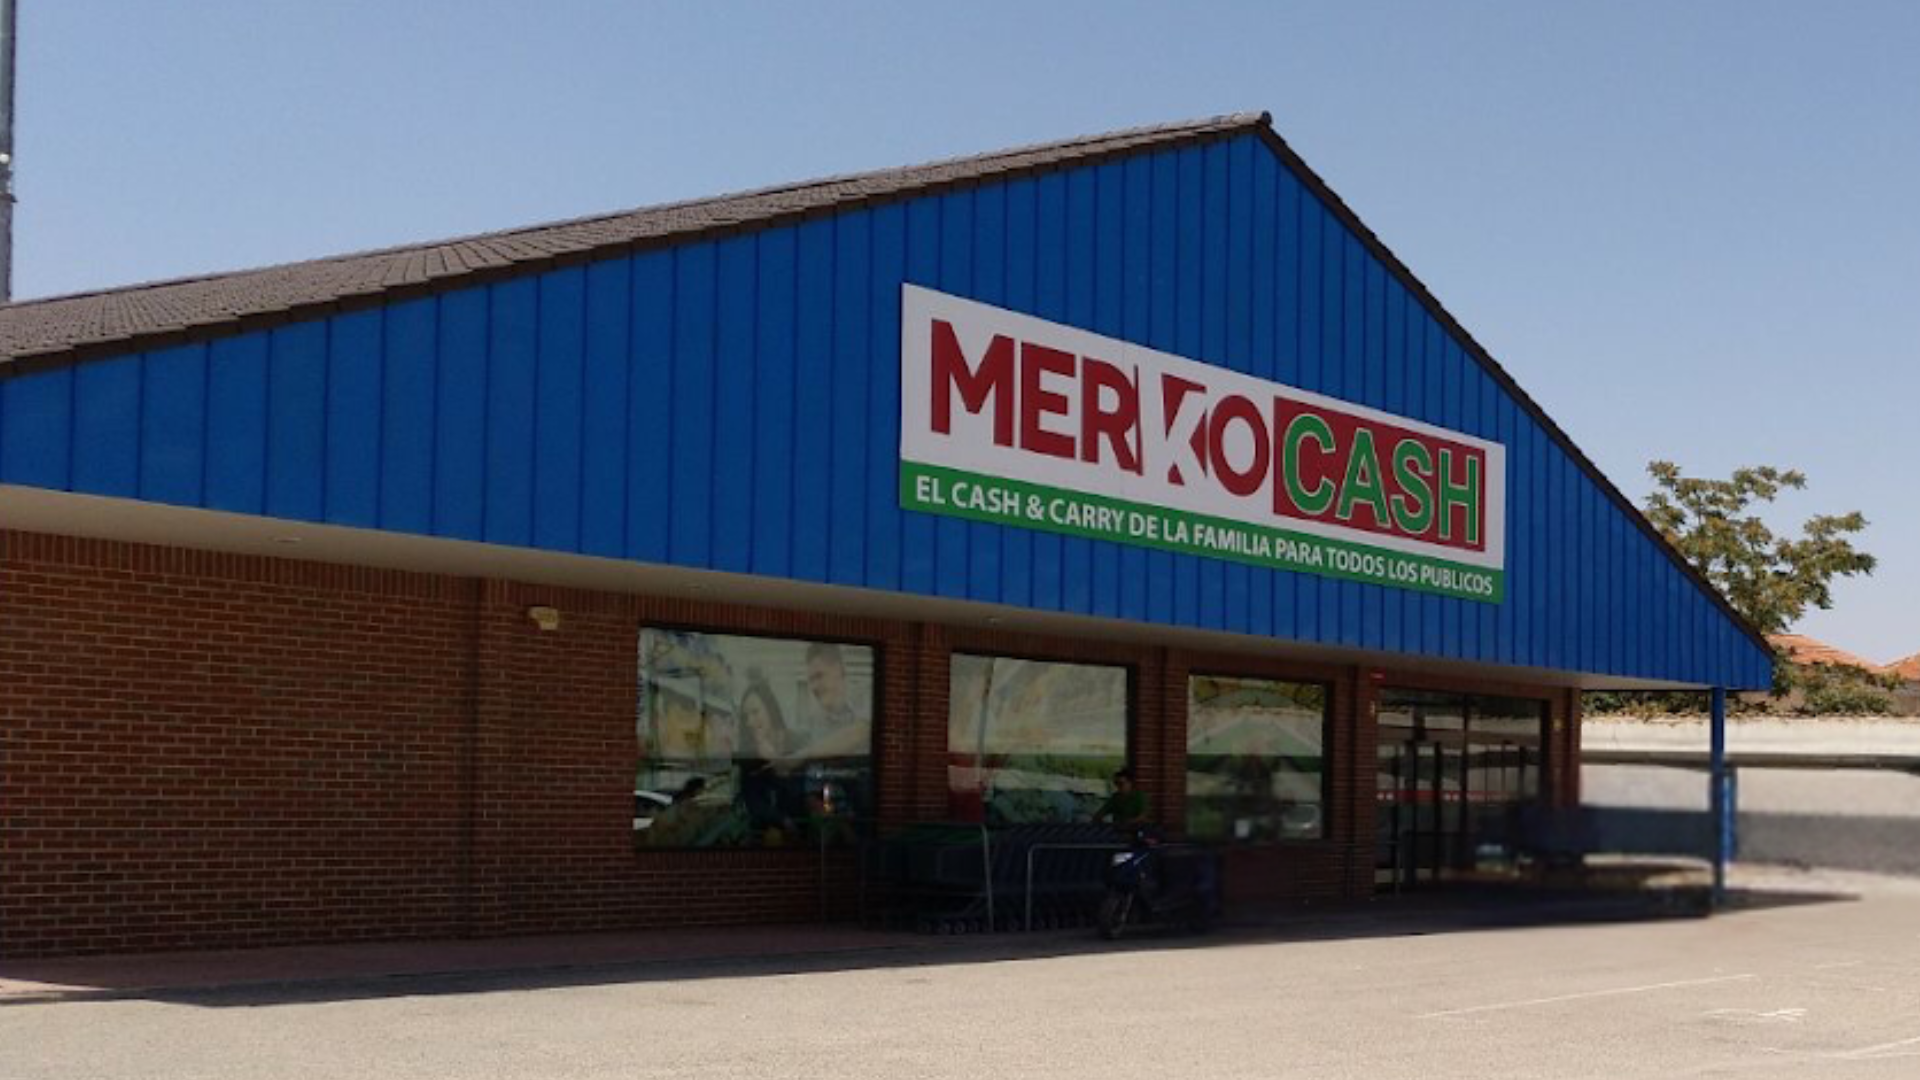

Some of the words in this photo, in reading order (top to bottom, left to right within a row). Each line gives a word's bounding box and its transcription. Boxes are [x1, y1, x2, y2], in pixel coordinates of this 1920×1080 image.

[931, 318, 1270, 497] MERKO
[1282, 413, 1479, 545] CASH
[916, 475, 946, 505] EL
[951, 481, 1019, 516] CASH
[1026, 494, 1044, 520] &
[1049, 498, 1125, 532] CARRY
[1129, 512, 1159, 538] DE
[1163, 518, 1188, 544] LA
[1193, 524, 1271, 557] FAMILIA
[1275, 540, 1323, 567] PARA
[1327, 547, 1385, 578] TODOS
[1388, 558, 1417, 583] LOS
[1420, 567, 1493, 595] PUBLICOS
